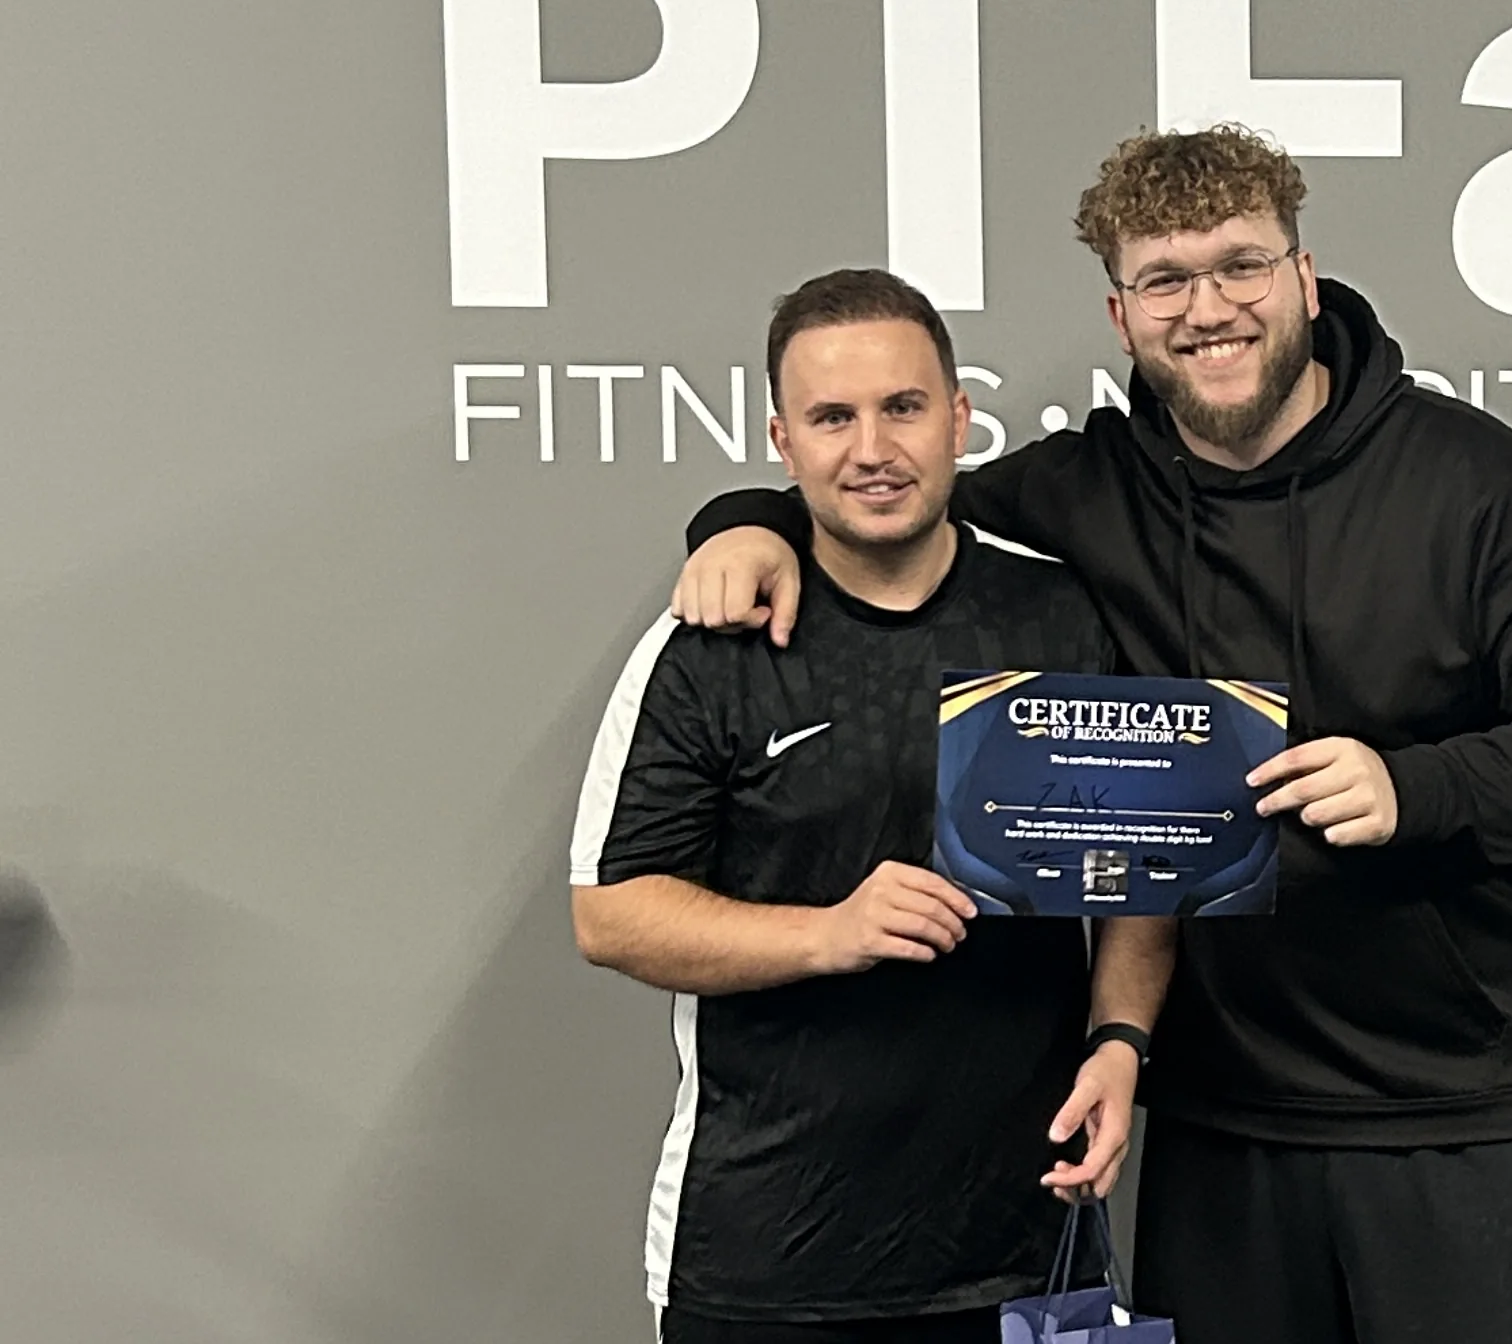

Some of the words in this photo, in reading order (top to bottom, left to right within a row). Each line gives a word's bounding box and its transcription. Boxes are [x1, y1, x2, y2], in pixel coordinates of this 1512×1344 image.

[453, 365, 1007, 465] FITNS
[1008, 698, 1211, 732] CERTIFICATE
[1051, 726, 1073, 740] OF
[1074, 727, 1175, 744] RECOGNITION
